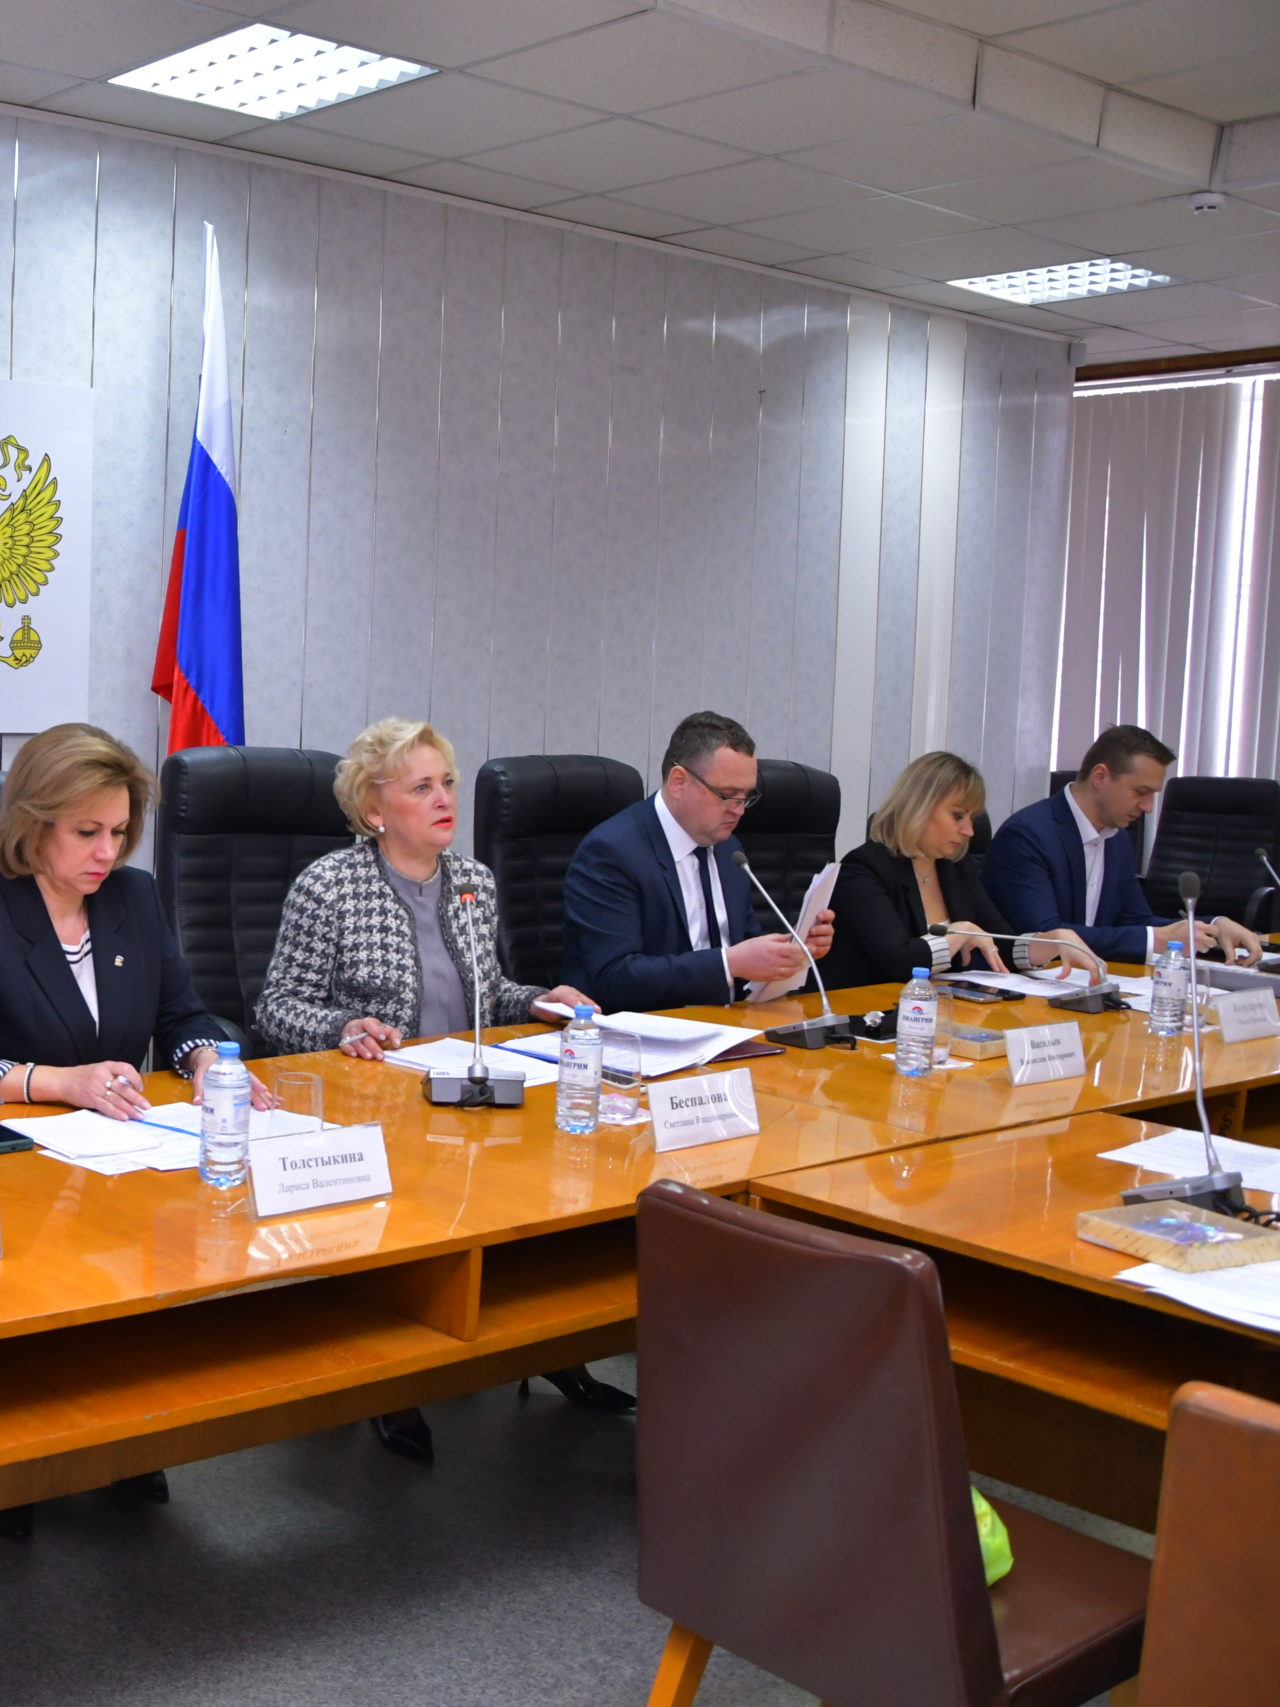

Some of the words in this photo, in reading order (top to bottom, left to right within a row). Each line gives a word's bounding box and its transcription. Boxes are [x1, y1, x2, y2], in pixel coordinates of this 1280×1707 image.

[669, 1091, 729, 1110] Беспалова
[278, 1152, 364, 1171] Толстыкина
[278, 1182, 310, 1194] Лариса
